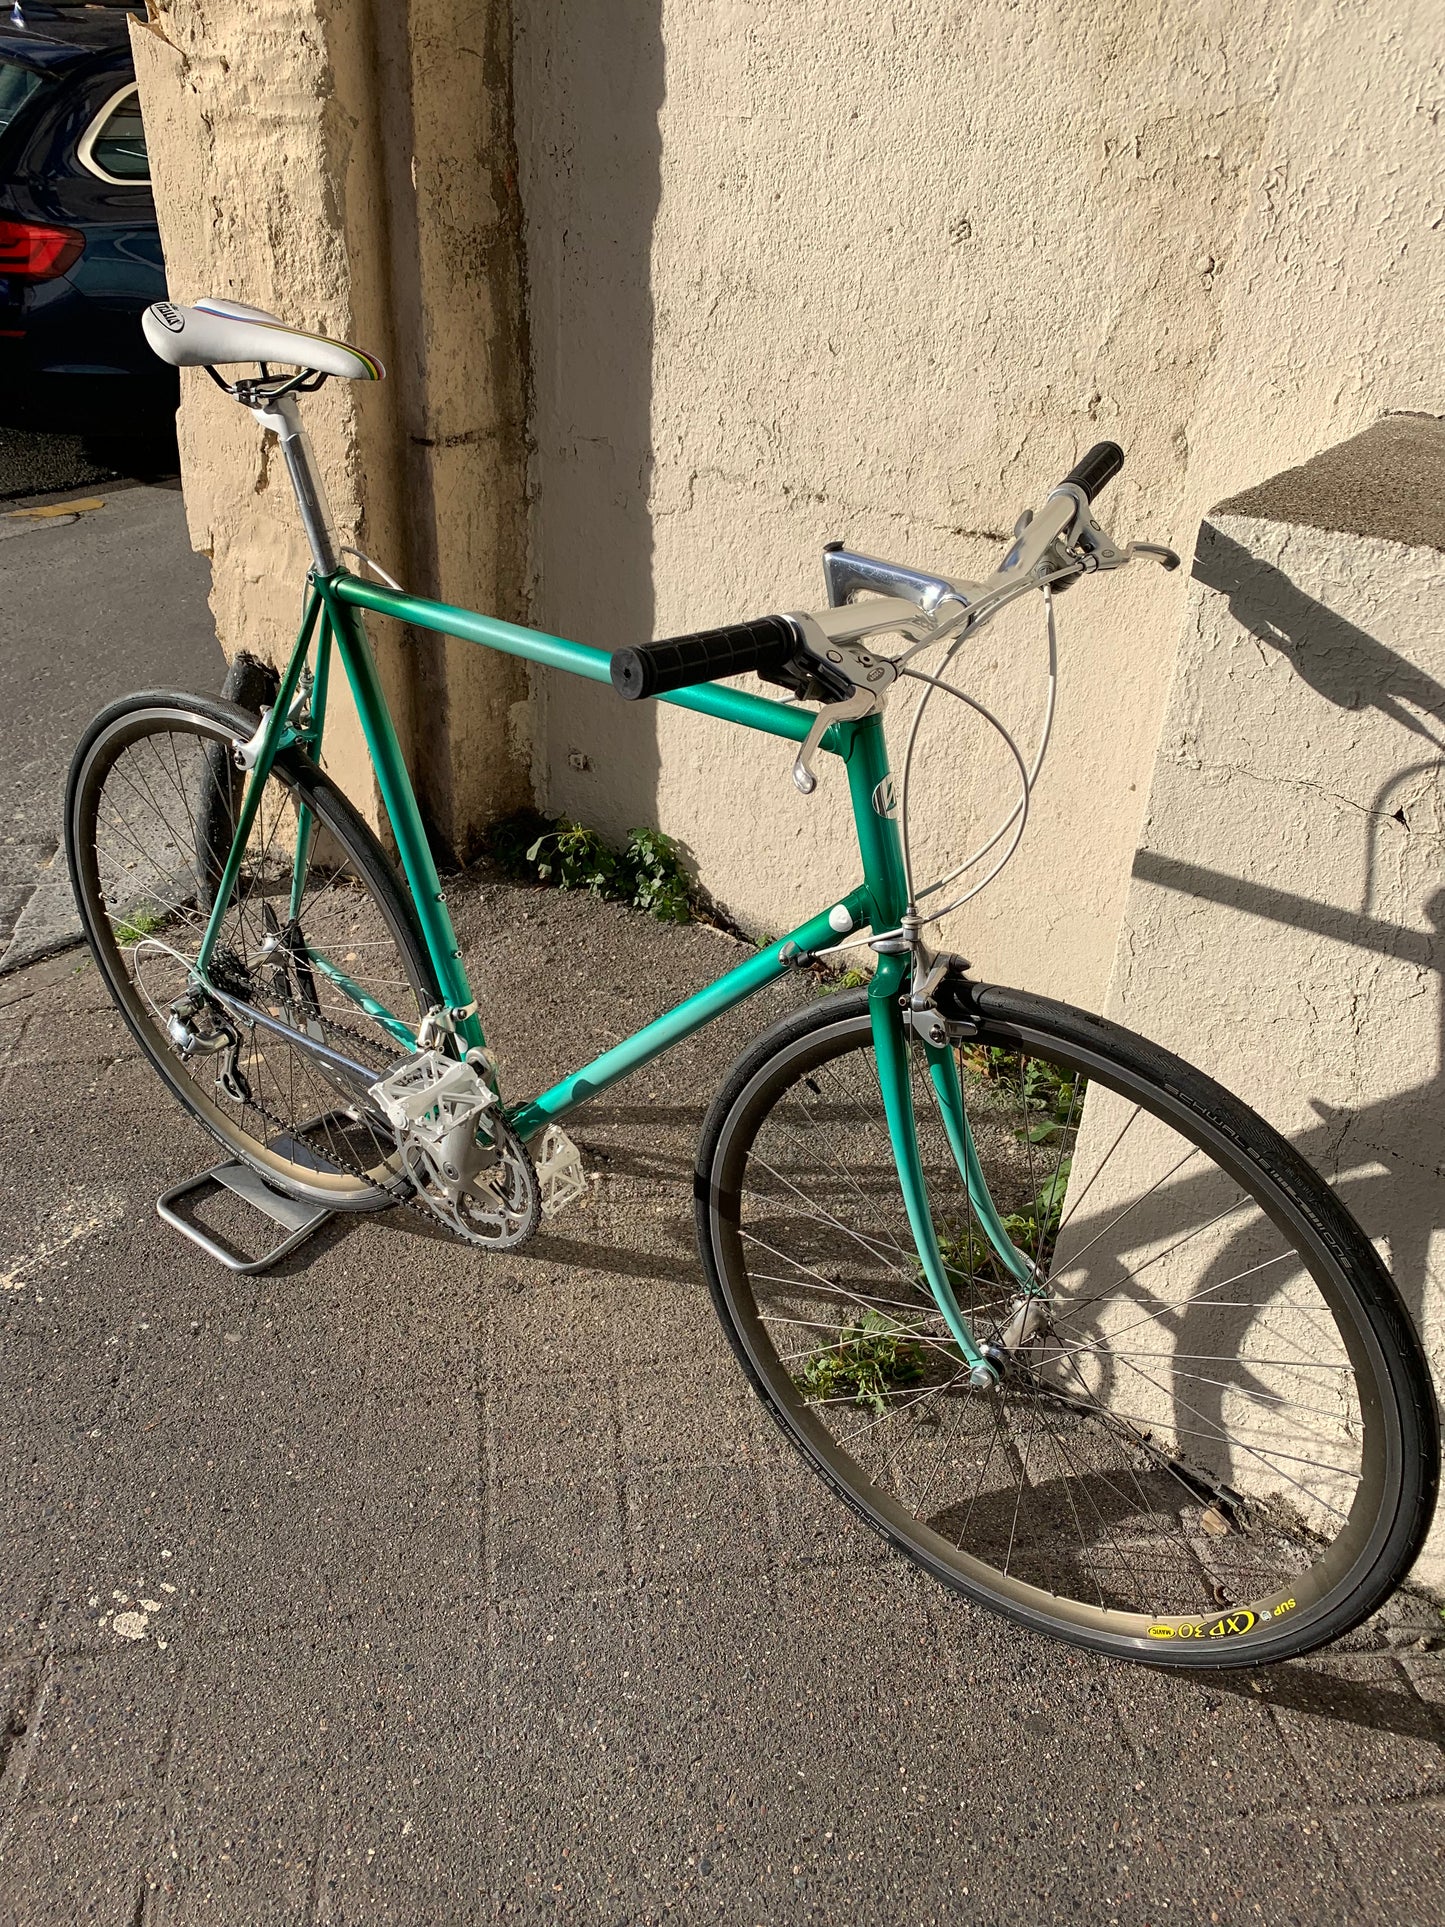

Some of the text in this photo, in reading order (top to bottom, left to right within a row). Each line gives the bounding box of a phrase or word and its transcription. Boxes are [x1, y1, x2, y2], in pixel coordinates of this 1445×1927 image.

[153, 303, 181, 326] ITALIA
[1163, 1082, 1272, 1170] SCHWALBE
[1273, 1598, 1297, 1617] SUP
